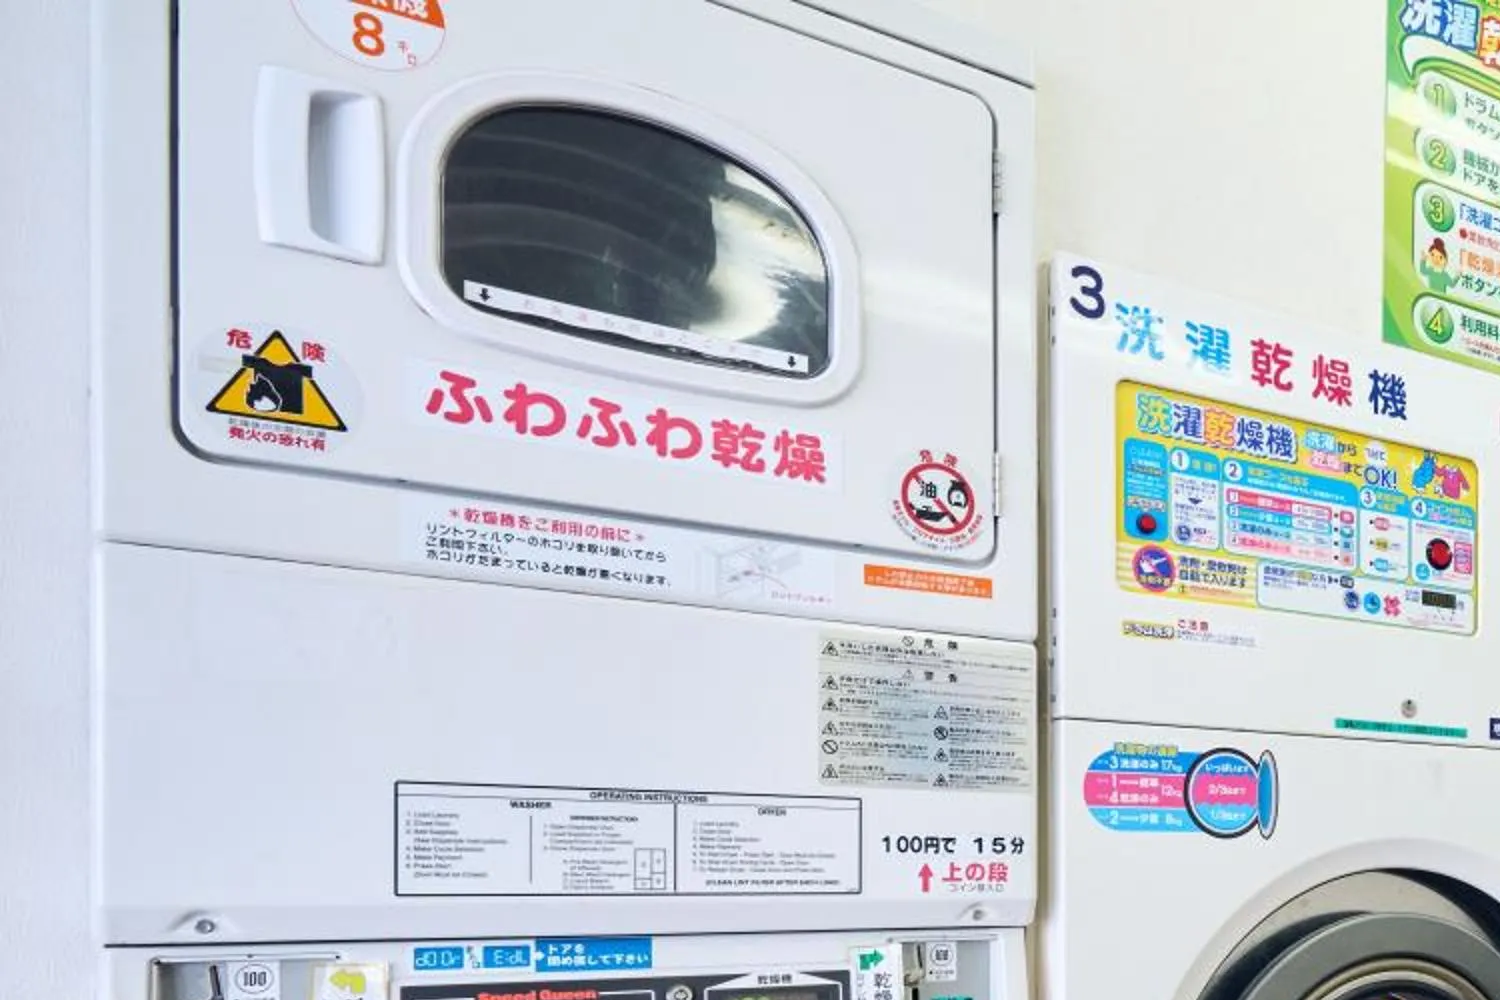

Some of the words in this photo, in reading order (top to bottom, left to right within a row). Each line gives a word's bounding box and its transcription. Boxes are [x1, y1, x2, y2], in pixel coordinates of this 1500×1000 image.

[352, 11, 385, 56] 8
[1069, 265, 1106, 319] 3
[1115, 301, 1408, 421] 洗濯乾燥機
[425, 370, 826, 483] ふわふわ乾燥
[1136, 393, 1296, 460] 洗濯乾燥機
[920, 480, 938, 499] 油
[1364, 466, 1397, 489] OK!
[882, 835, 957, 854] 100円で
[973, 836, 1025, 855] 15分
[942, 861, 1008, 882] 上の段
[243, 971, 267, 988] 100
